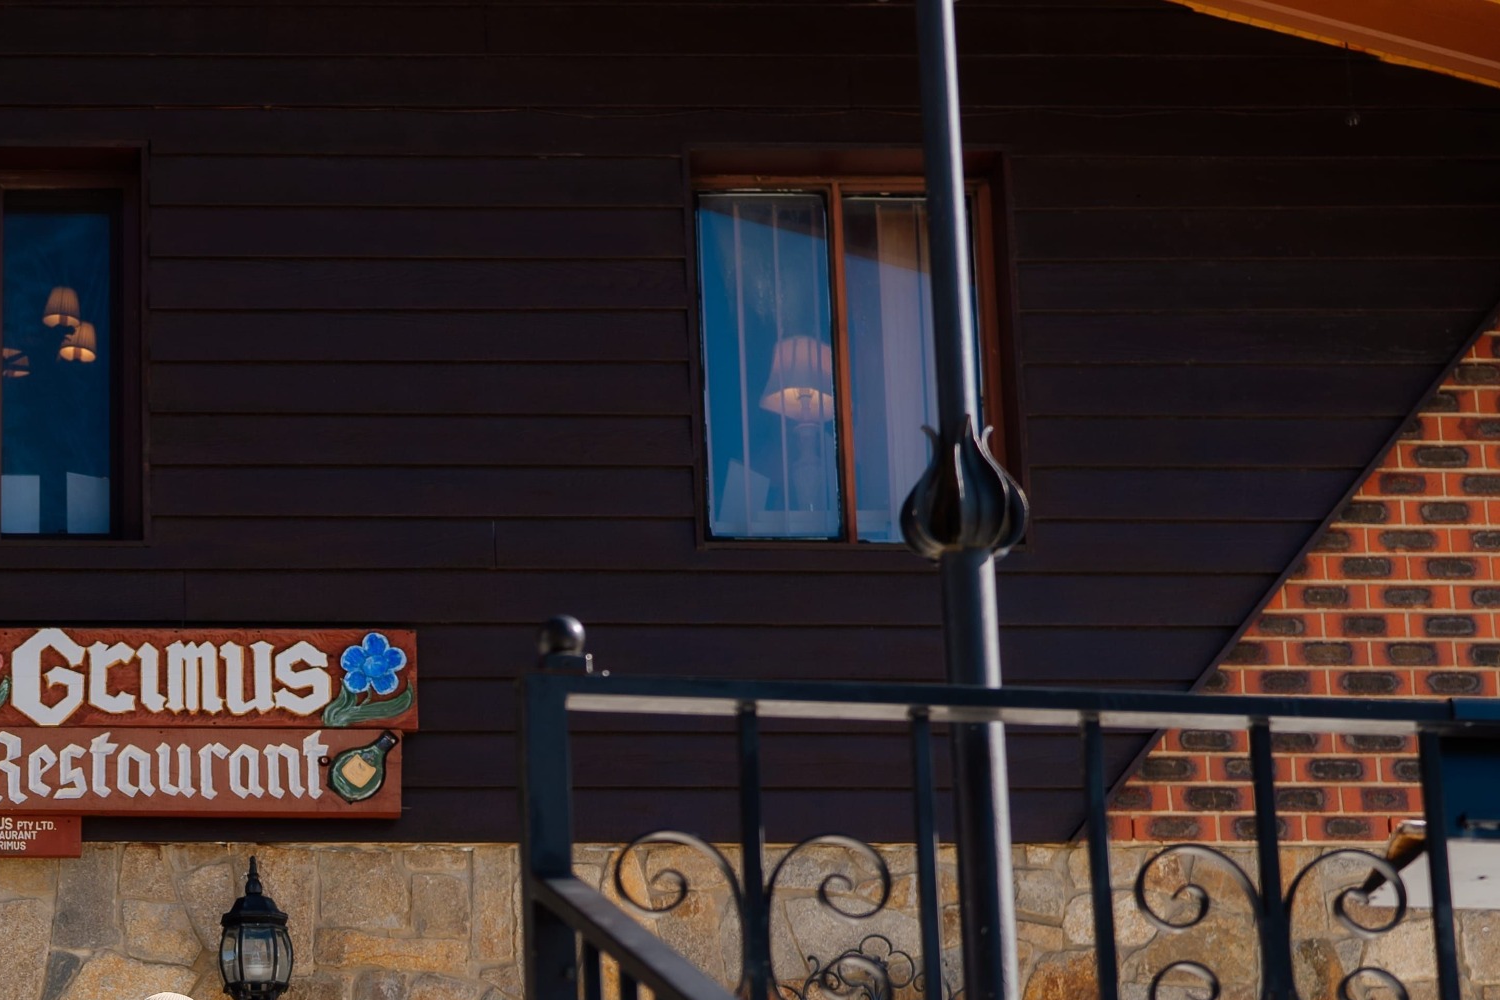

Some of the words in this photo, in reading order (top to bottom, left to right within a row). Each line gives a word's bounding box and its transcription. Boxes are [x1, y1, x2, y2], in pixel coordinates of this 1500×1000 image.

[10, 628, 332, 727] Grimus
[16, 821, 34, 831] PTY
[35, 821, 57, 831] LTD.
